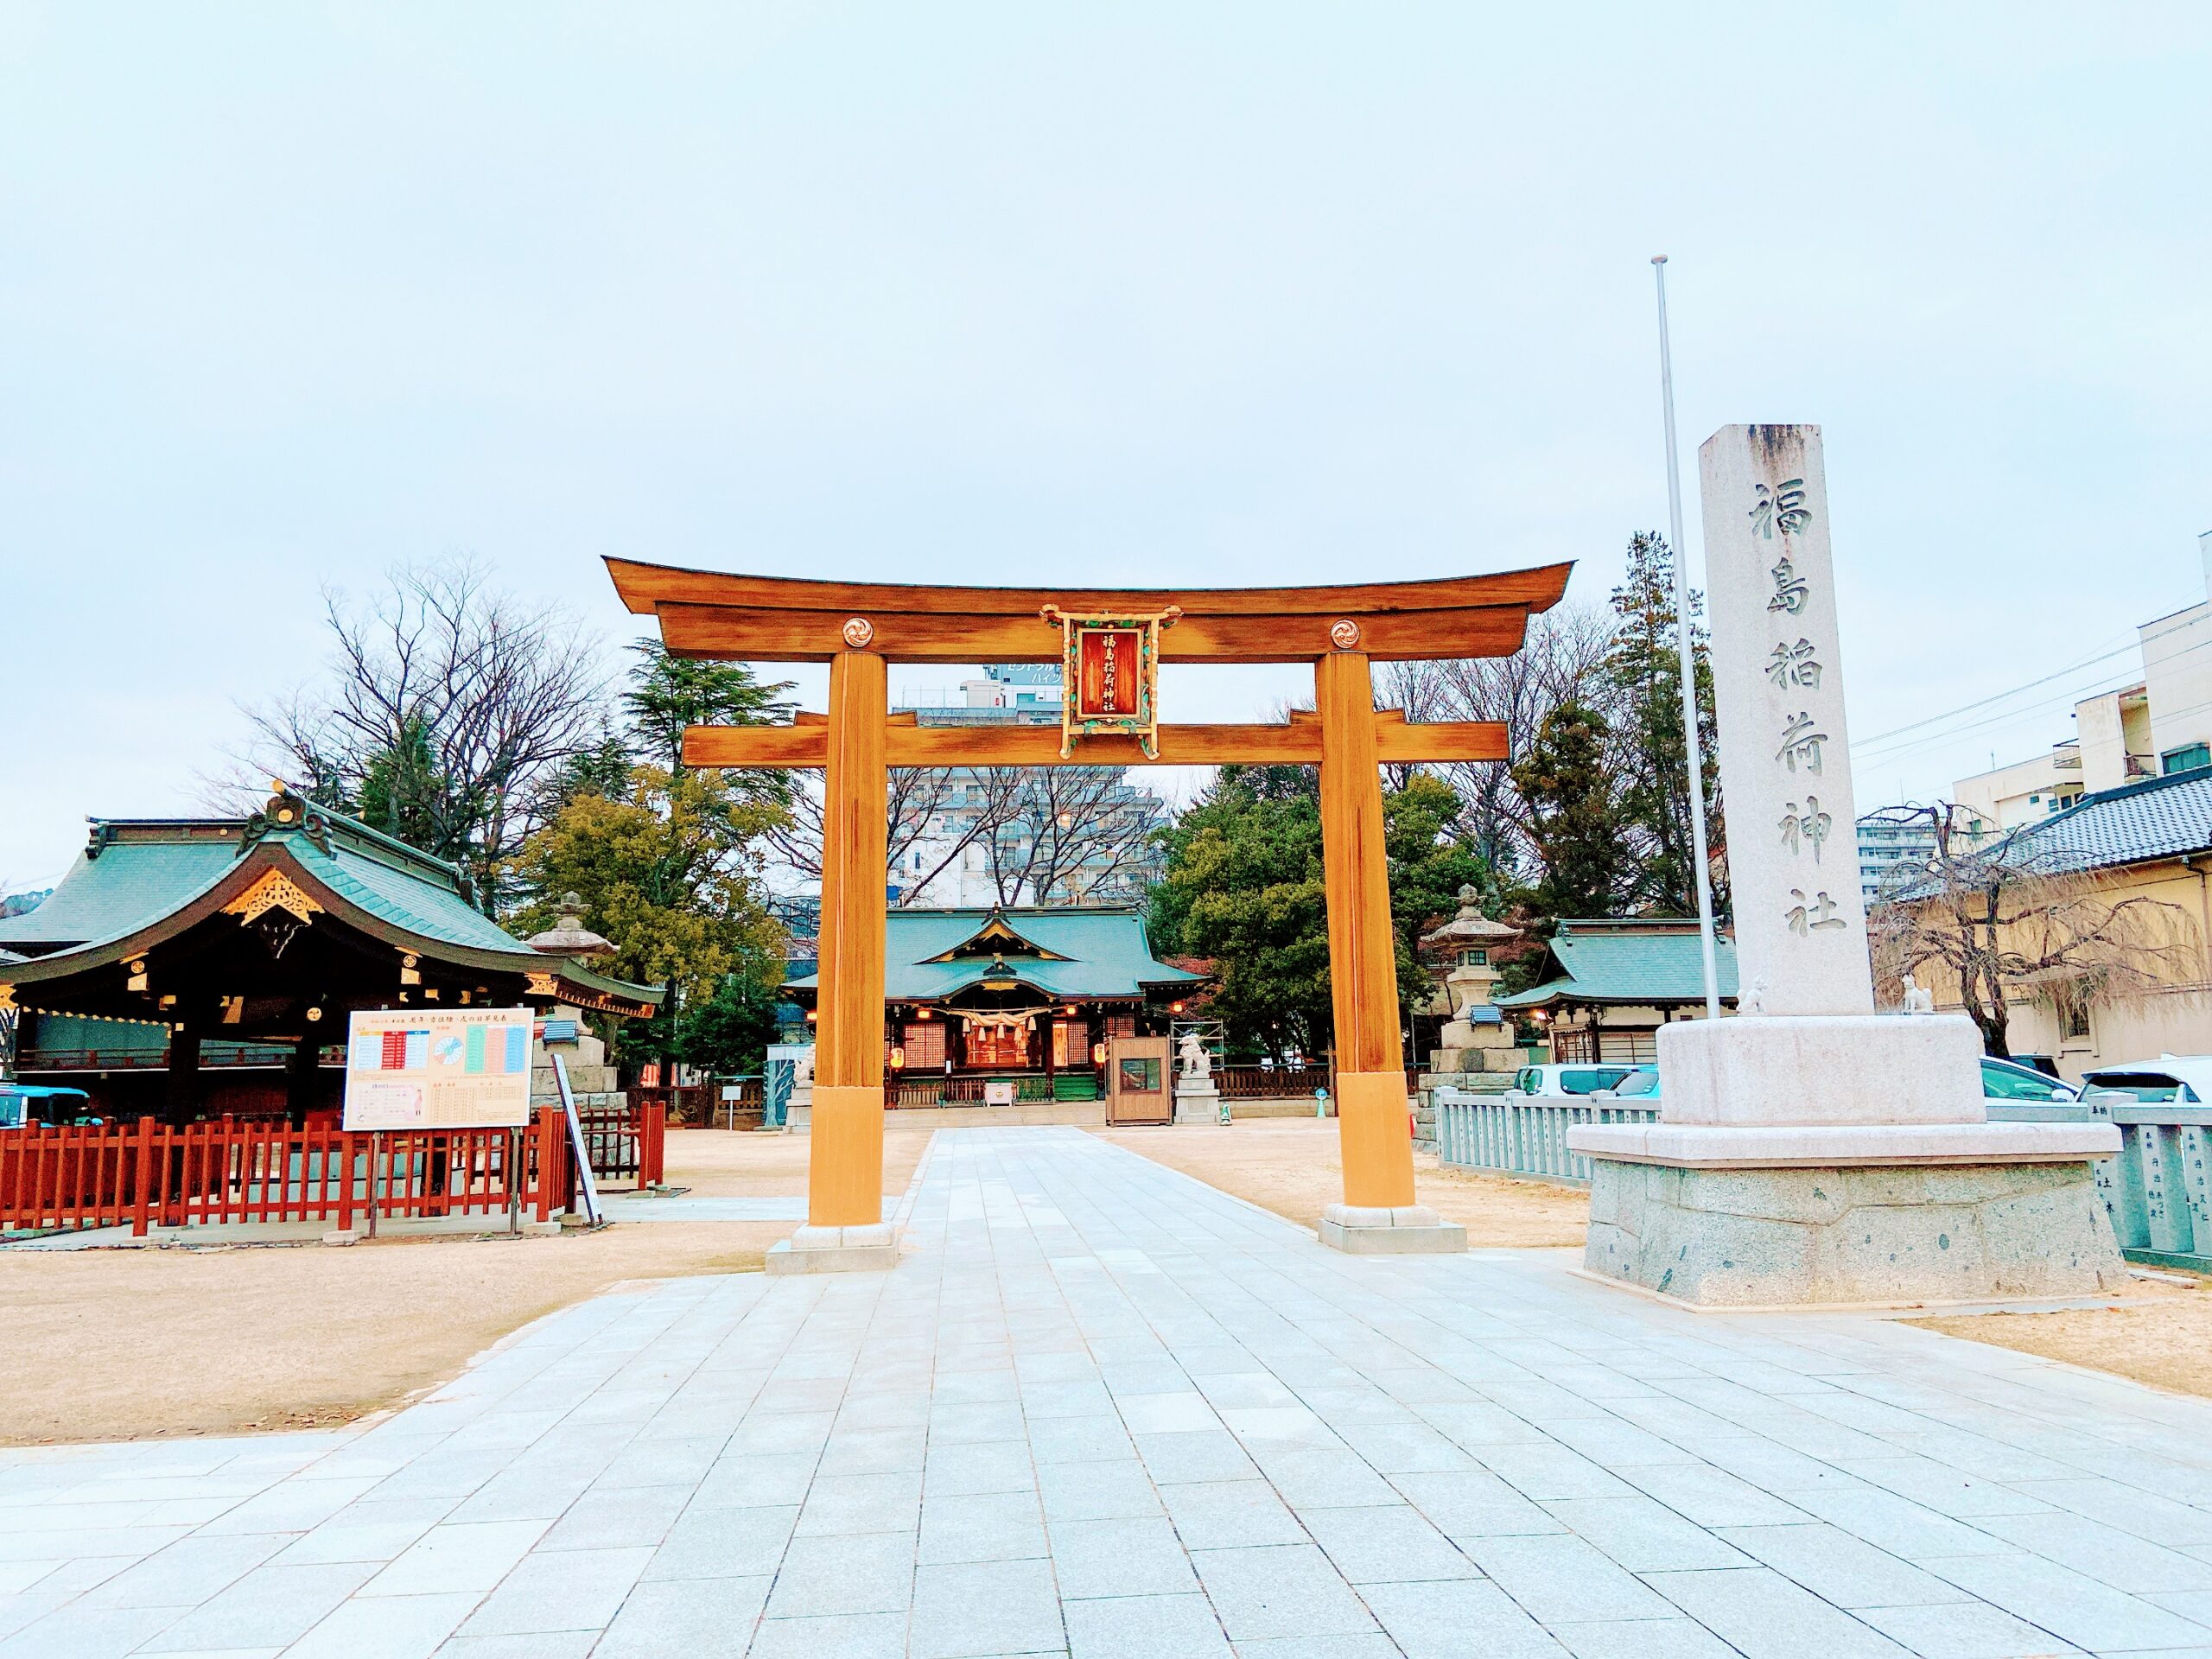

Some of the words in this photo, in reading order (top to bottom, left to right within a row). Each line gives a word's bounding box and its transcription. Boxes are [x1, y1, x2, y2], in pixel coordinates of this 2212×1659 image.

[1032, 673, 1062, 683] ハイツ
[1103, 634, 1116, 712] 福島稲荷神社
[1748, 478, 1847, 938] 福島稲荷神社
